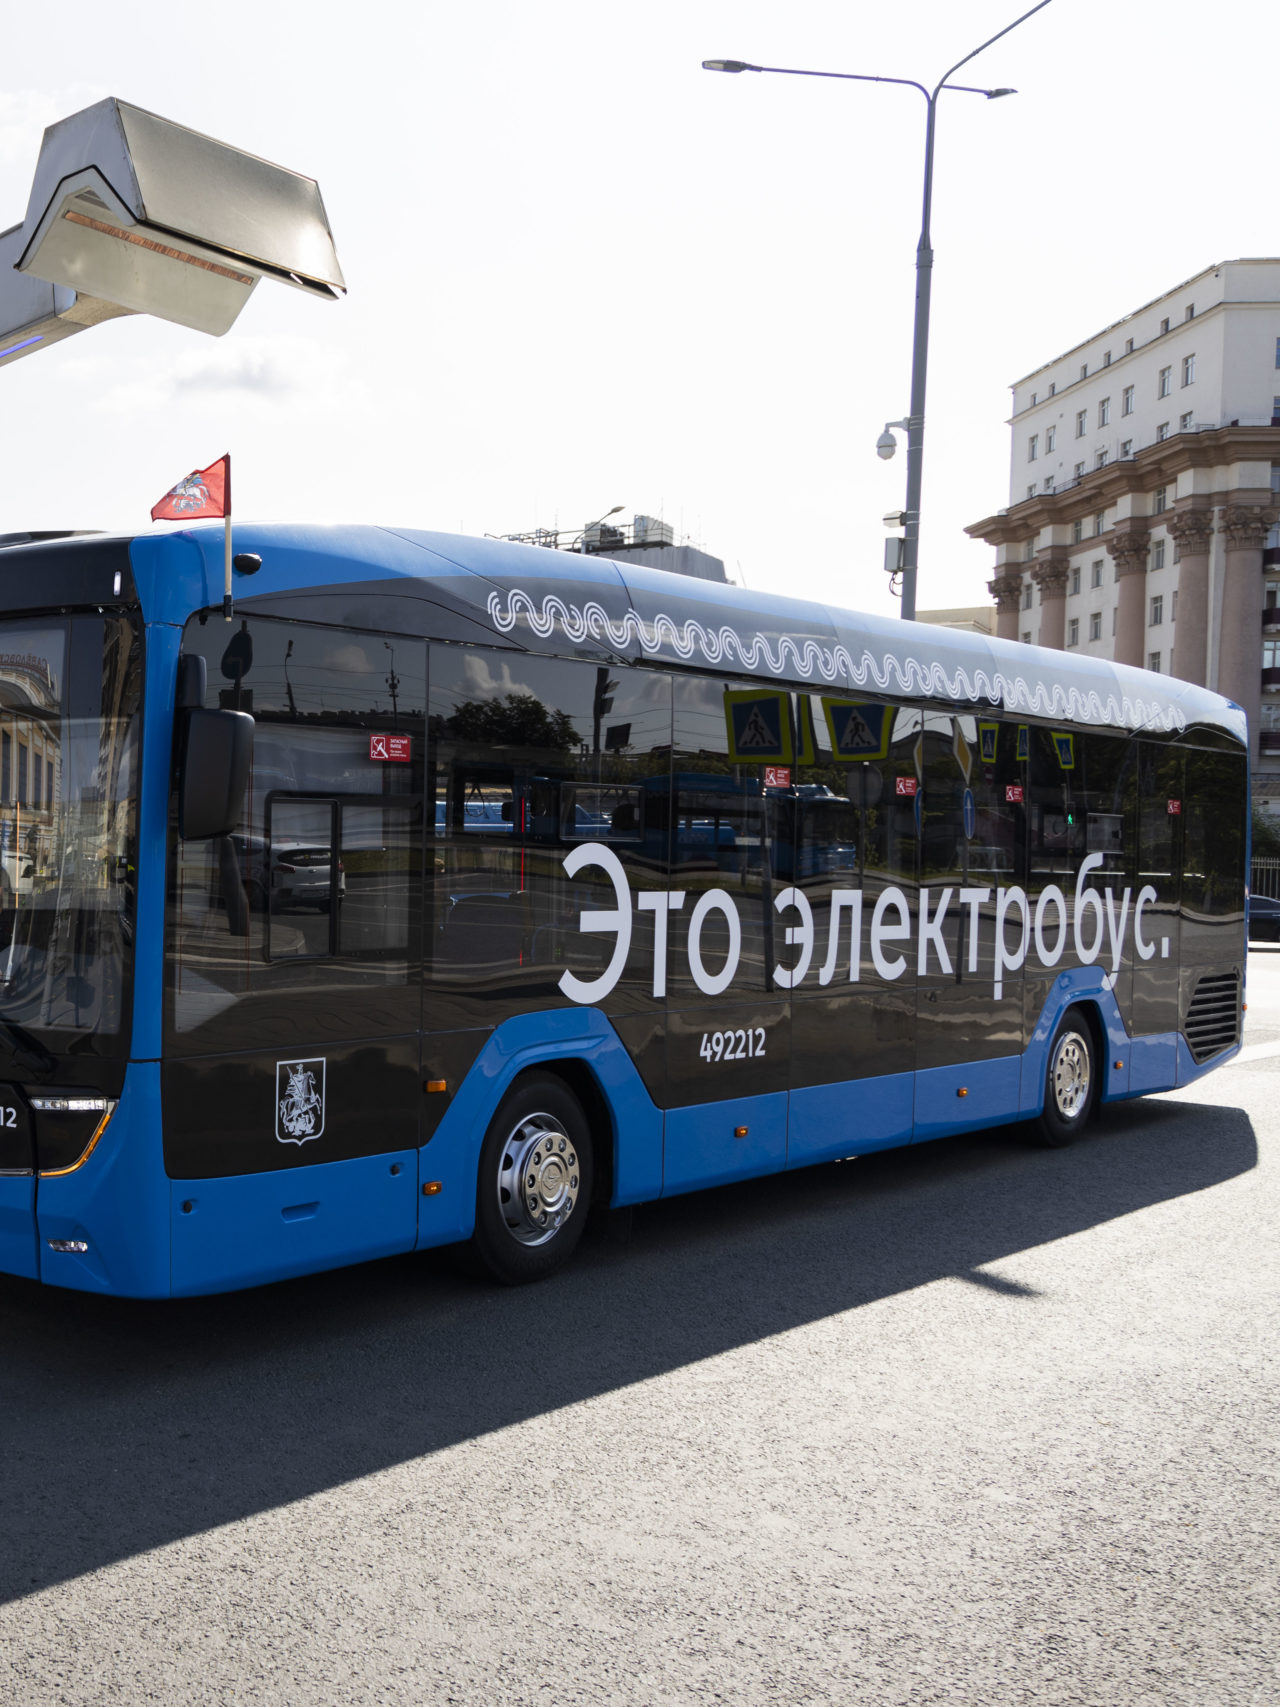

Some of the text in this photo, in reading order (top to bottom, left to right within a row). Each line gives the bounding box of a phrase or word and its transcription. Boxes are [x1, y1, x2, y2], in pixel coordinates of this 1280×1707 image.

[558, 842, 1170, 1004] Это электробус.
[699, 1027, 766, 1062] 492212
